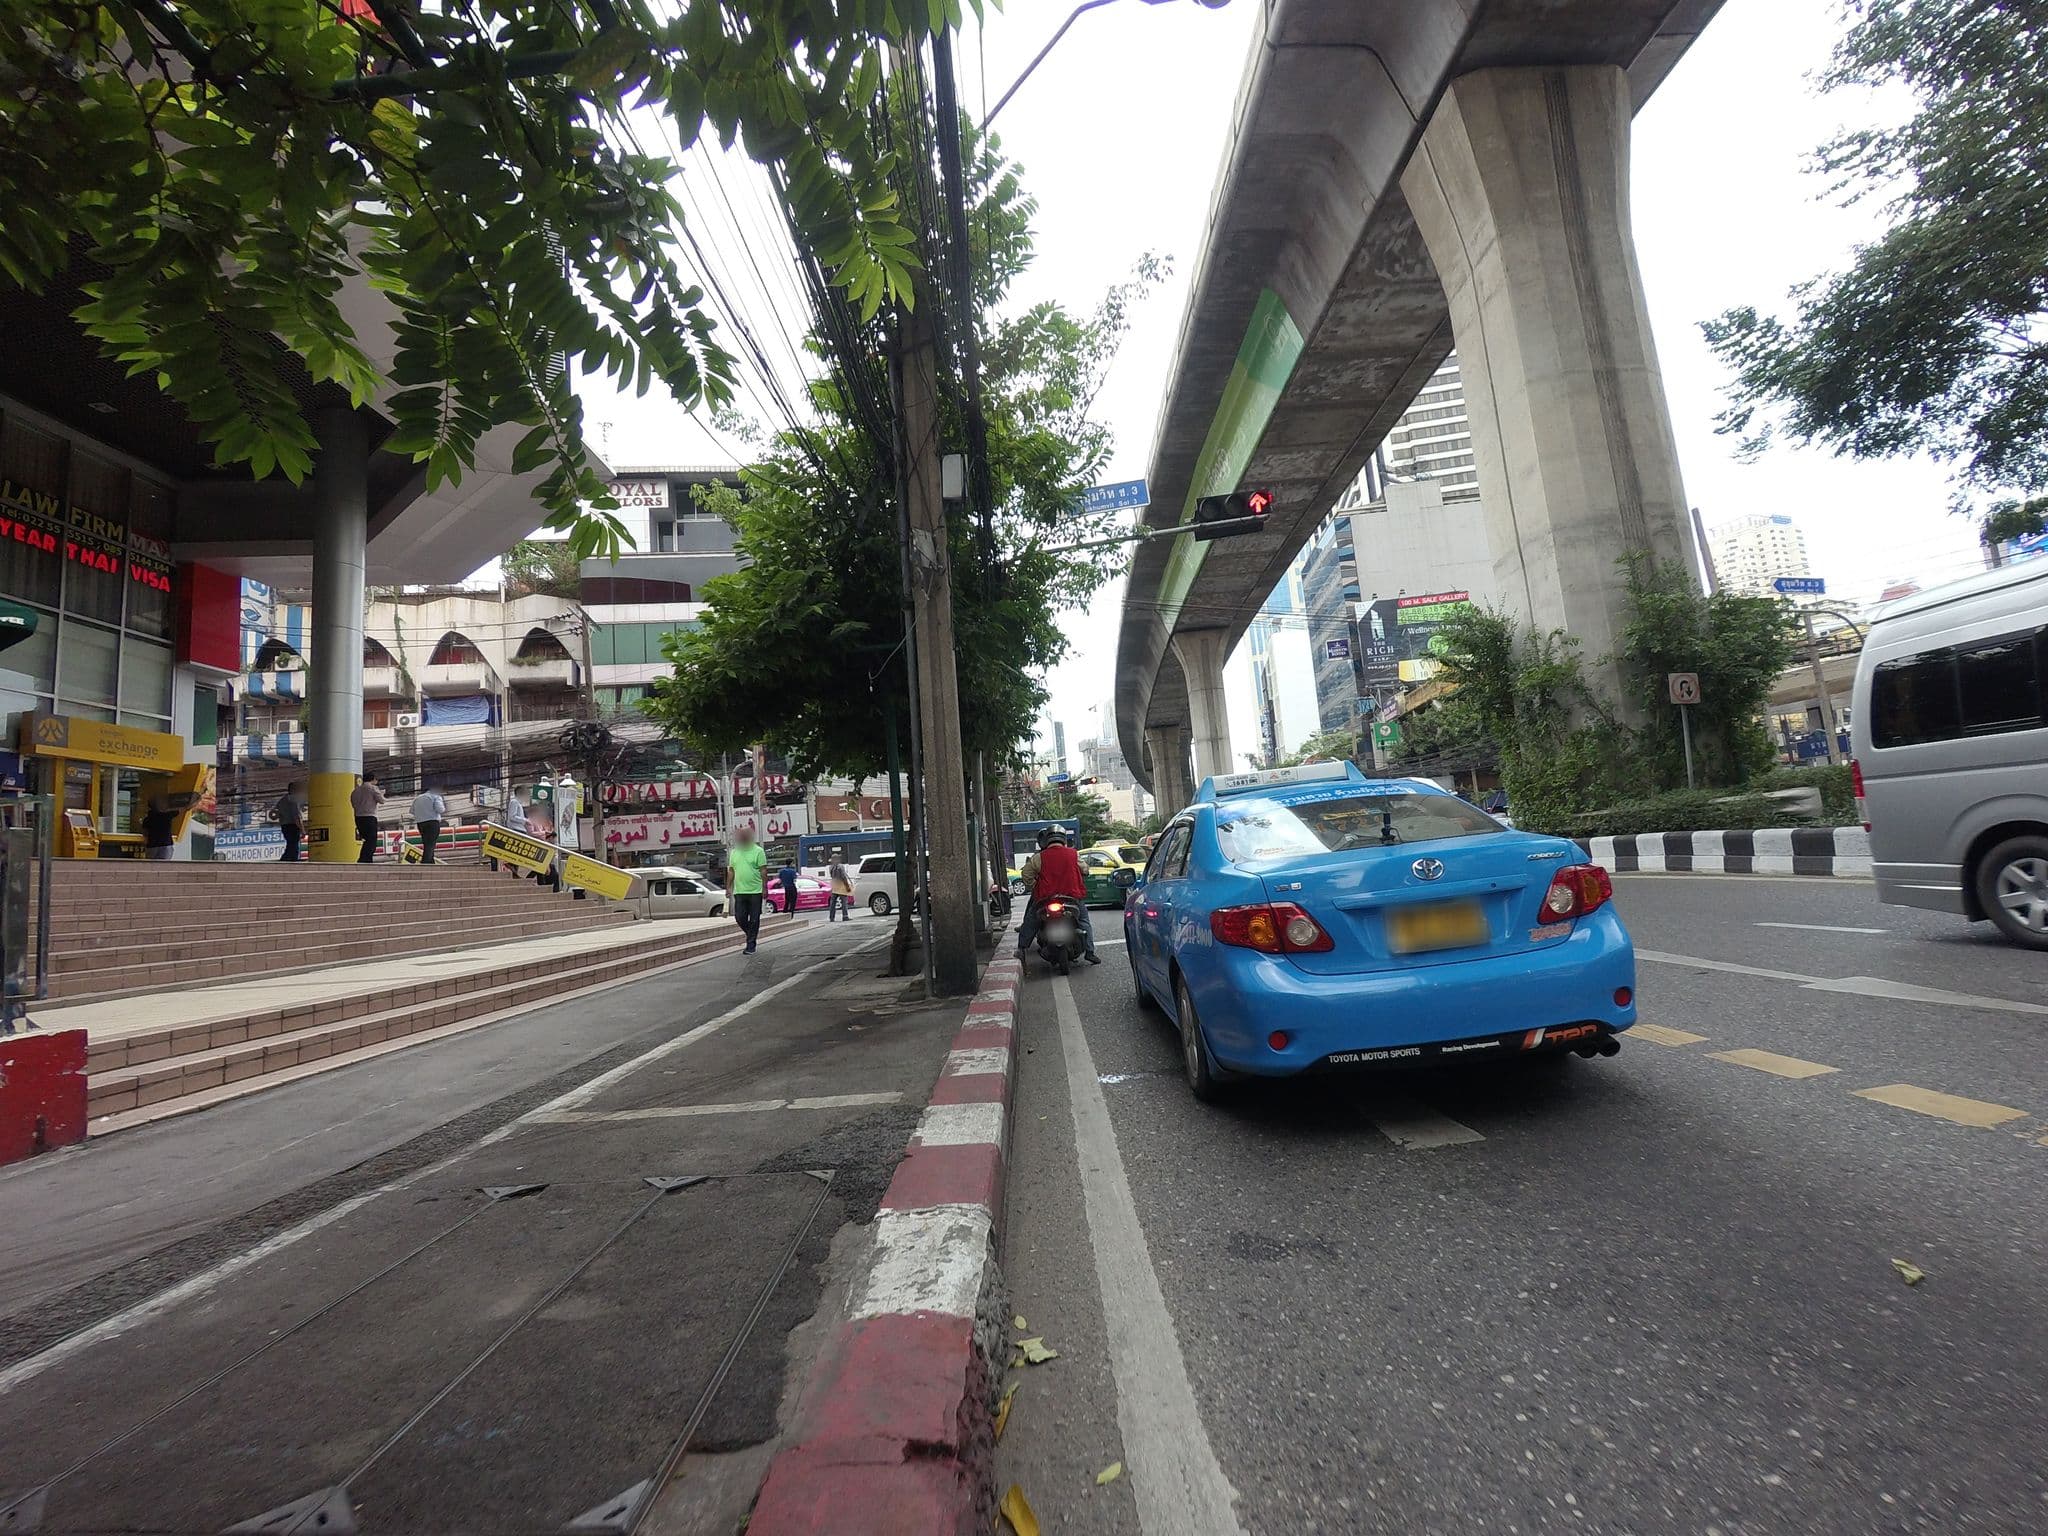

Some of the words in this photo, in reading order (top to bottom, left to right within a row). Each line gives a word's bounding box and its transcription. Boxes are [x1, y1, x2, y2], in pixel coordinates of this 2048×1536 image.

[608, 482, 661, 496] OYAL
[617, 497, 662, 506] LORS
[2, 480, 60, 518] LAW
[71, 506, 125, 543] FIRM
[0, 517, 57, 554] YEAR
[66, 541, 119, 575] THAI
[130, 563, 171, 593] VISA
[1422, 595, 1438, 604] SALE
[1438, 592, 1468, 602] GALLERY
[1366, 645, 1394, 655] RICH
[98, 739, 159, 757] exchange
[605, 779, 680, 804] OYAL
[684, 774, 785, 801] TALOR
[494, 832, 538, 854] WESTERN
[504, 843, 537, 859] UNION
[226, 848, 262, 861] CHAROEN
[264, 846, 285, 858] OPTIC
[1463, 1040, 1500, 1050] Development
[1328, 1053, 1359, 1064] TOYOTA
[1361, 1051, 1390, 1061] MOTOR
[1390, 1048, 1421, 1059] SPORTS
